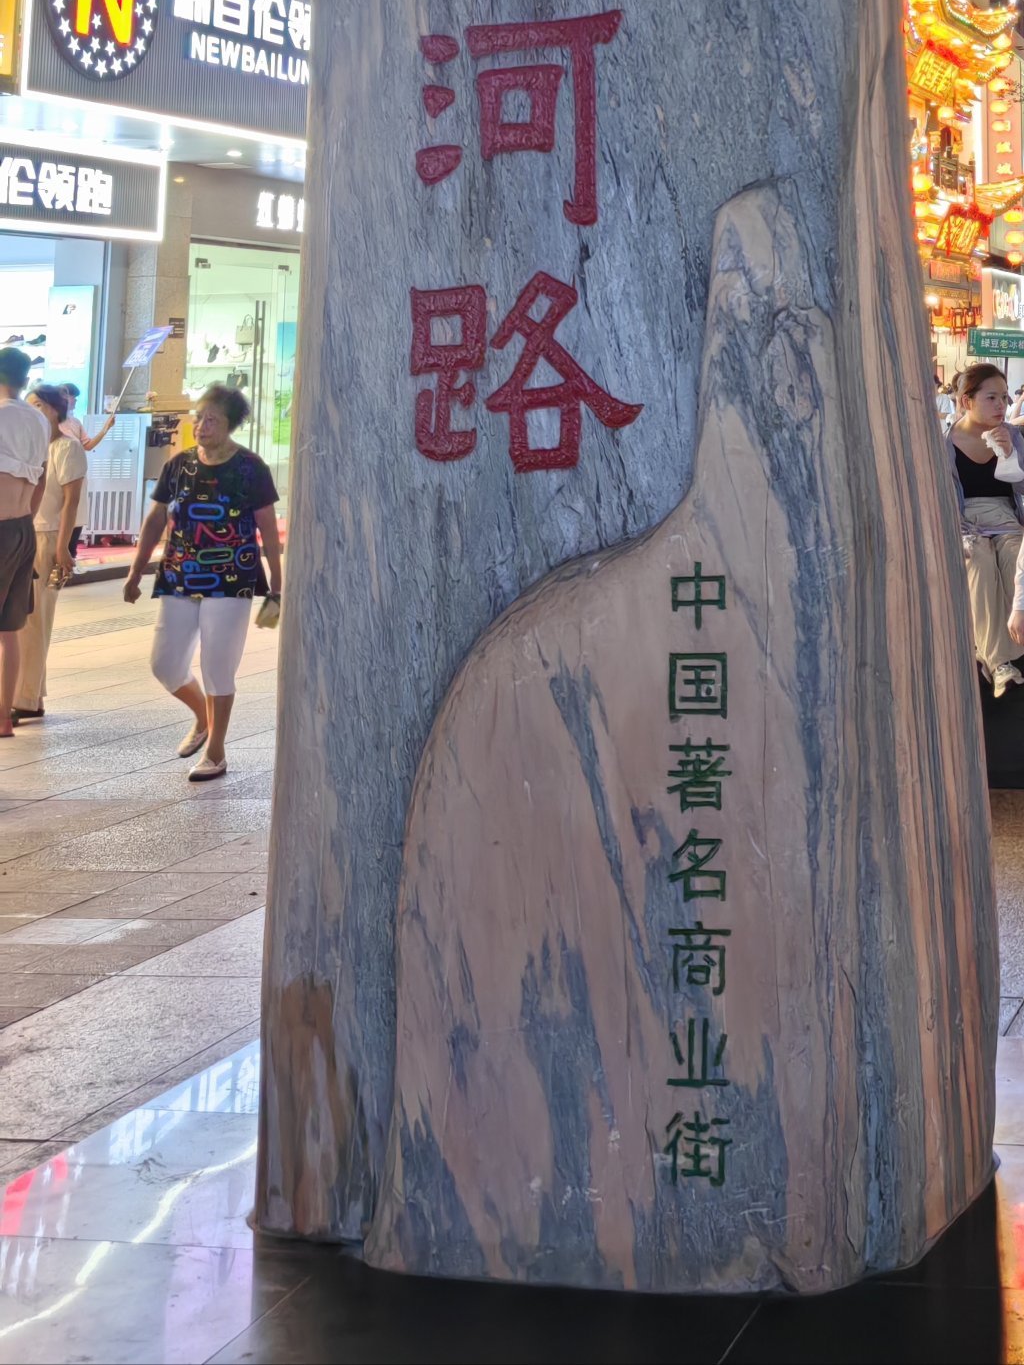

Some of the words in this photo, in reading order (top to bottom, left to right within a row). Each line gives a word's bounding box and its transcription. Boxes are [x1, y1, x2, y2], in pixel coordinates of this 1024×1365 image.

[664, 561, 732, 1187] 中国著名商业街
